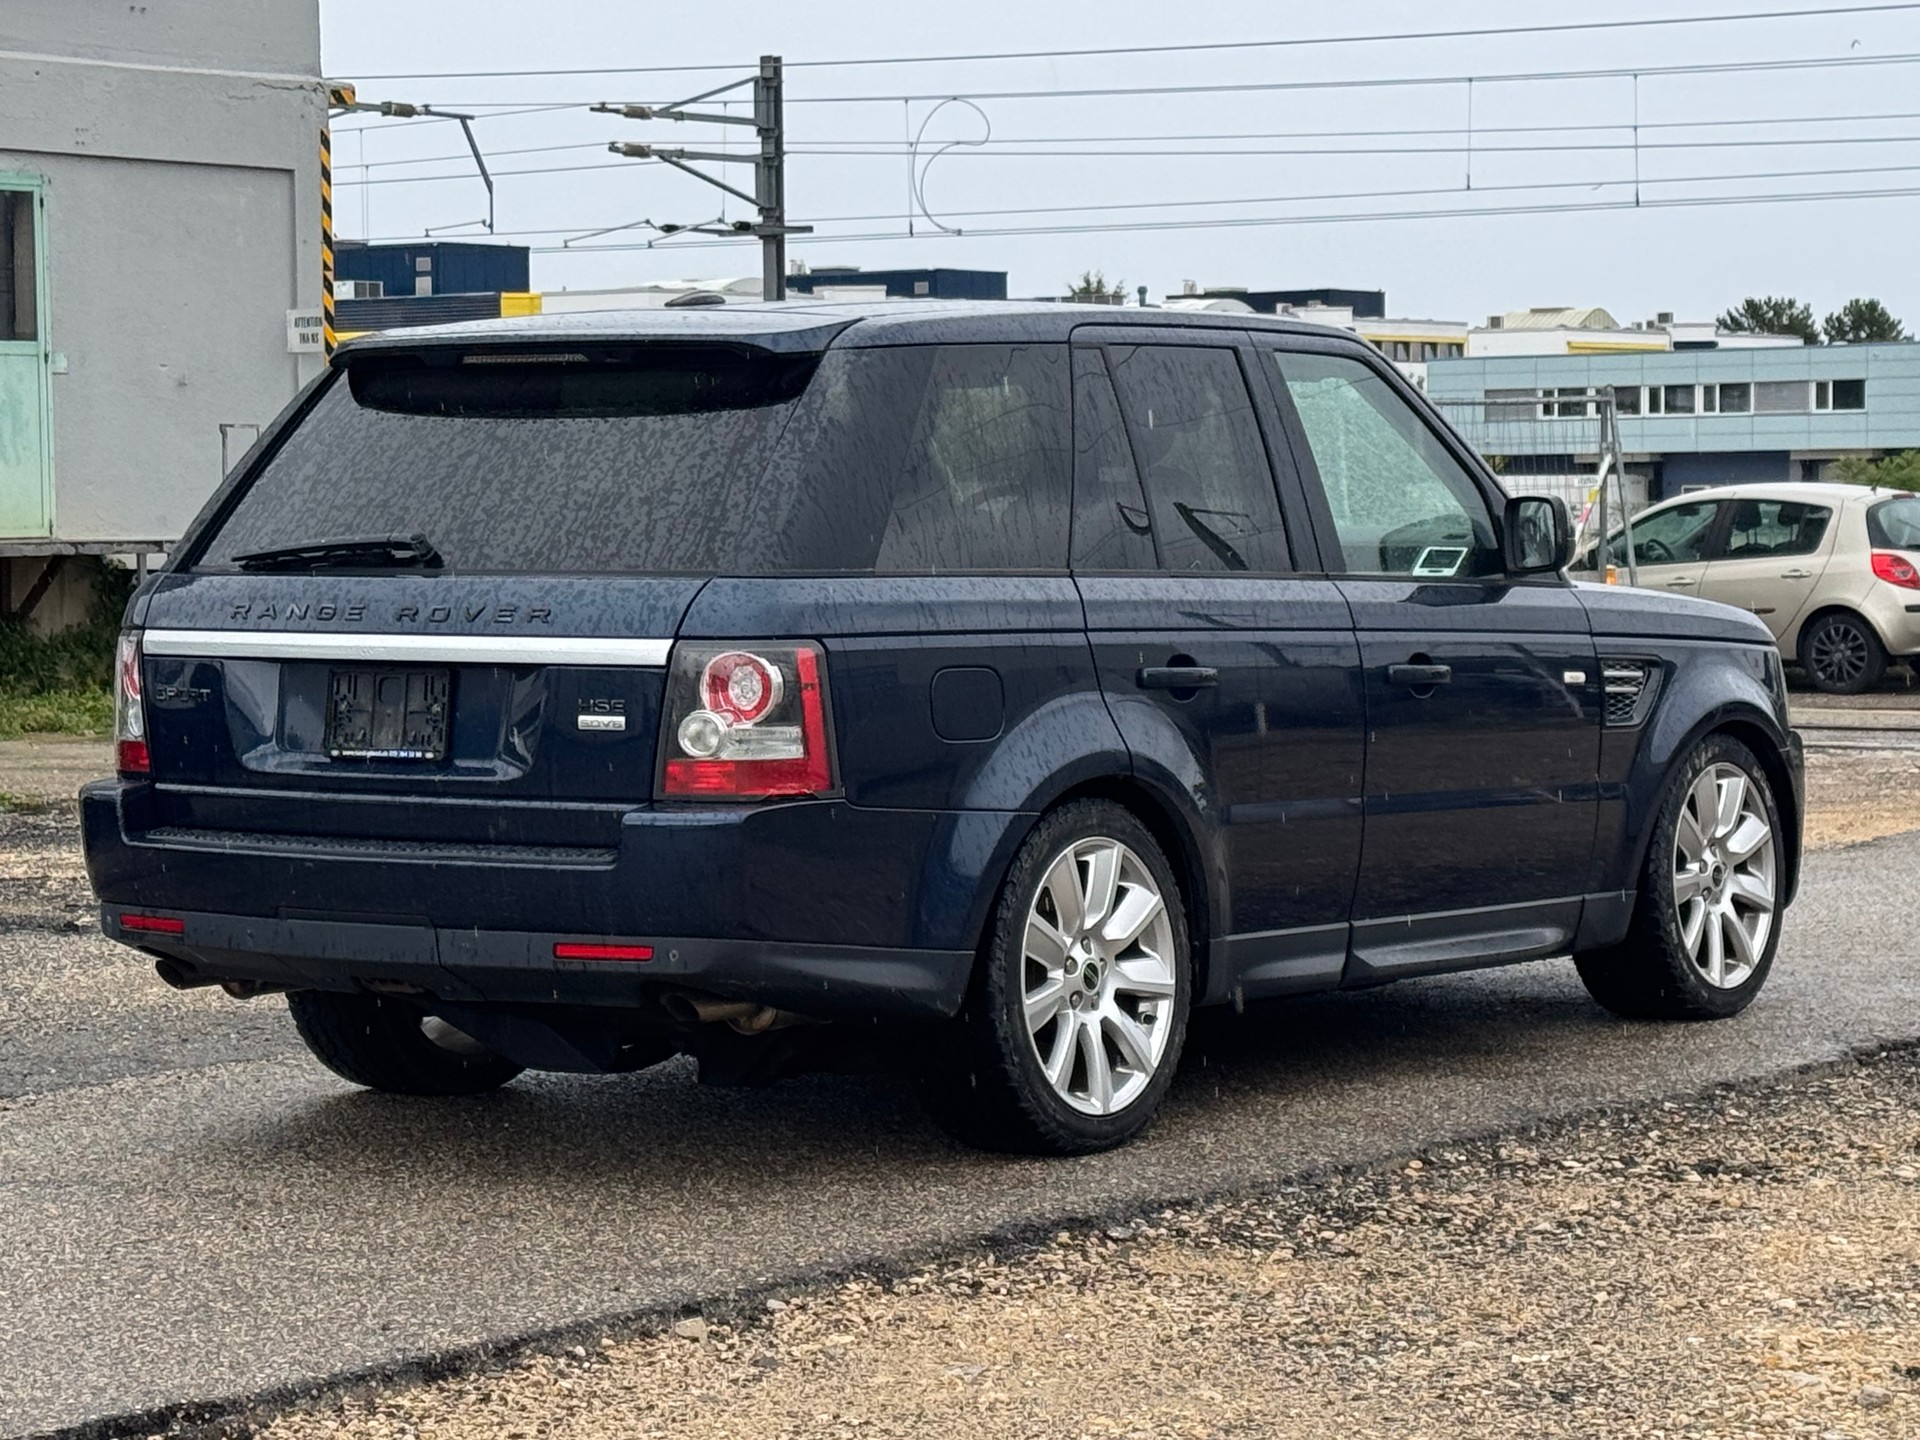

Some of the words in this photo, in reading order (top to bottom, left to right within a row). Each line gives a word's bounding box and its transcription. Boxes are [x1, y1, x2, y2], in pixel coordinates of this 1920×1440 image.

[230, 603, 367, 622] RANGE
[396, 604, 552, 624] ROVER
[577, 698, 625, 713] HSE
